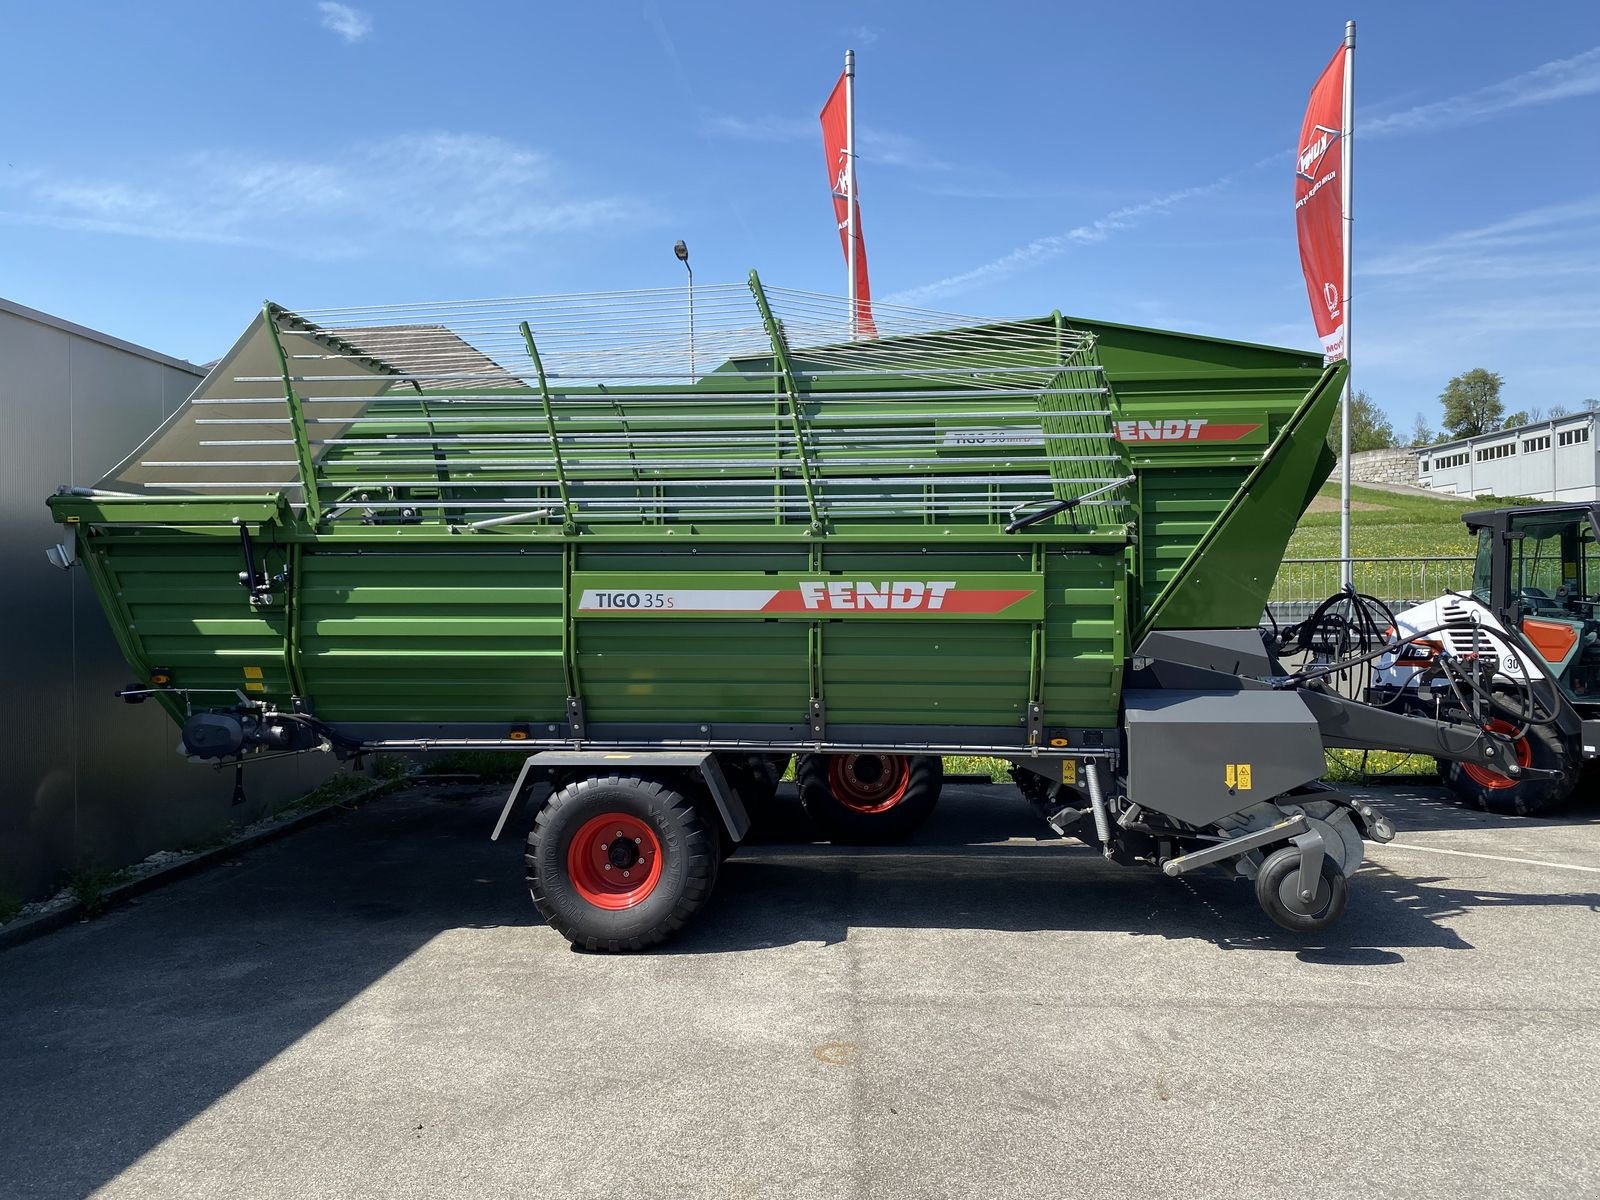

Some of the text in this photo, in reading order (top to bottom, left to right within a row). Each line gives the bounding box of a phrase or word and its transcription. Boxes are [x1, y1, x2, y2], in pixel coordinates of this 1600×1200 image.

[1112, 419, 1208, 441] ENDT
[595, 593, 641, 608] TIGO
[798, 581, 957, 610] FENDT
[1506, 660, 1519, 669] 30
